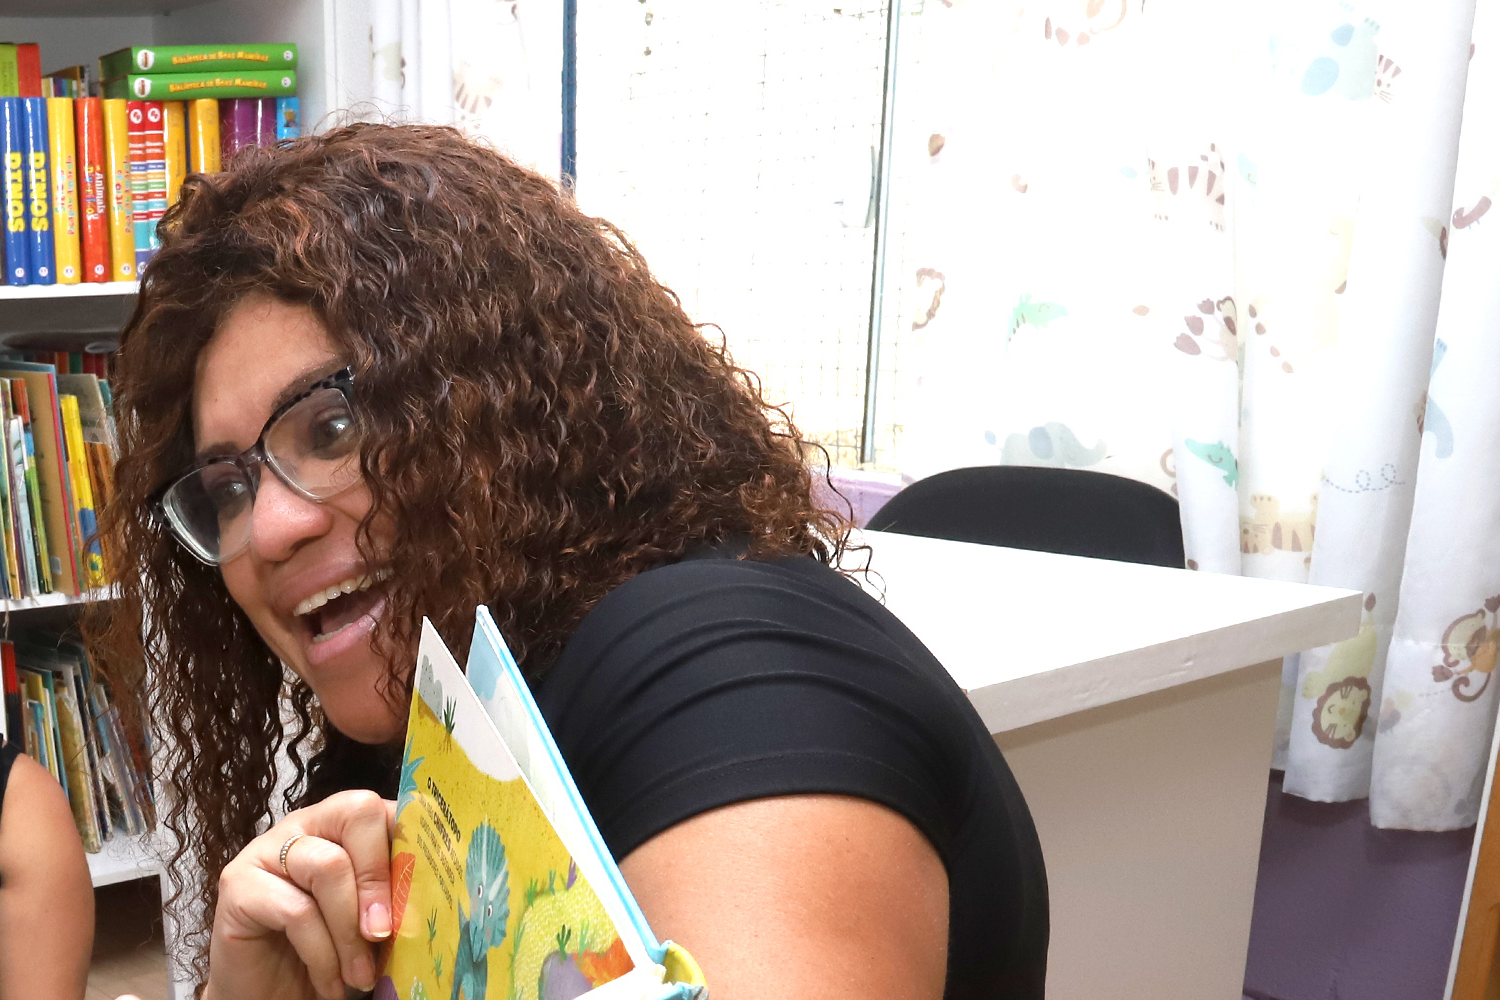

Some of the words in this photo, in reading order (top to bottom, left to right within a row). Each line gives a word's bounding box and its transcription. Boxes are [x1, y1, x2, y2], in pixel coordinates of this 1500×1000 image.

[5, 152, 25, 232] DINOS
[29, 152, 49, 231] DINOS
[427, 777, 431, 790] O
